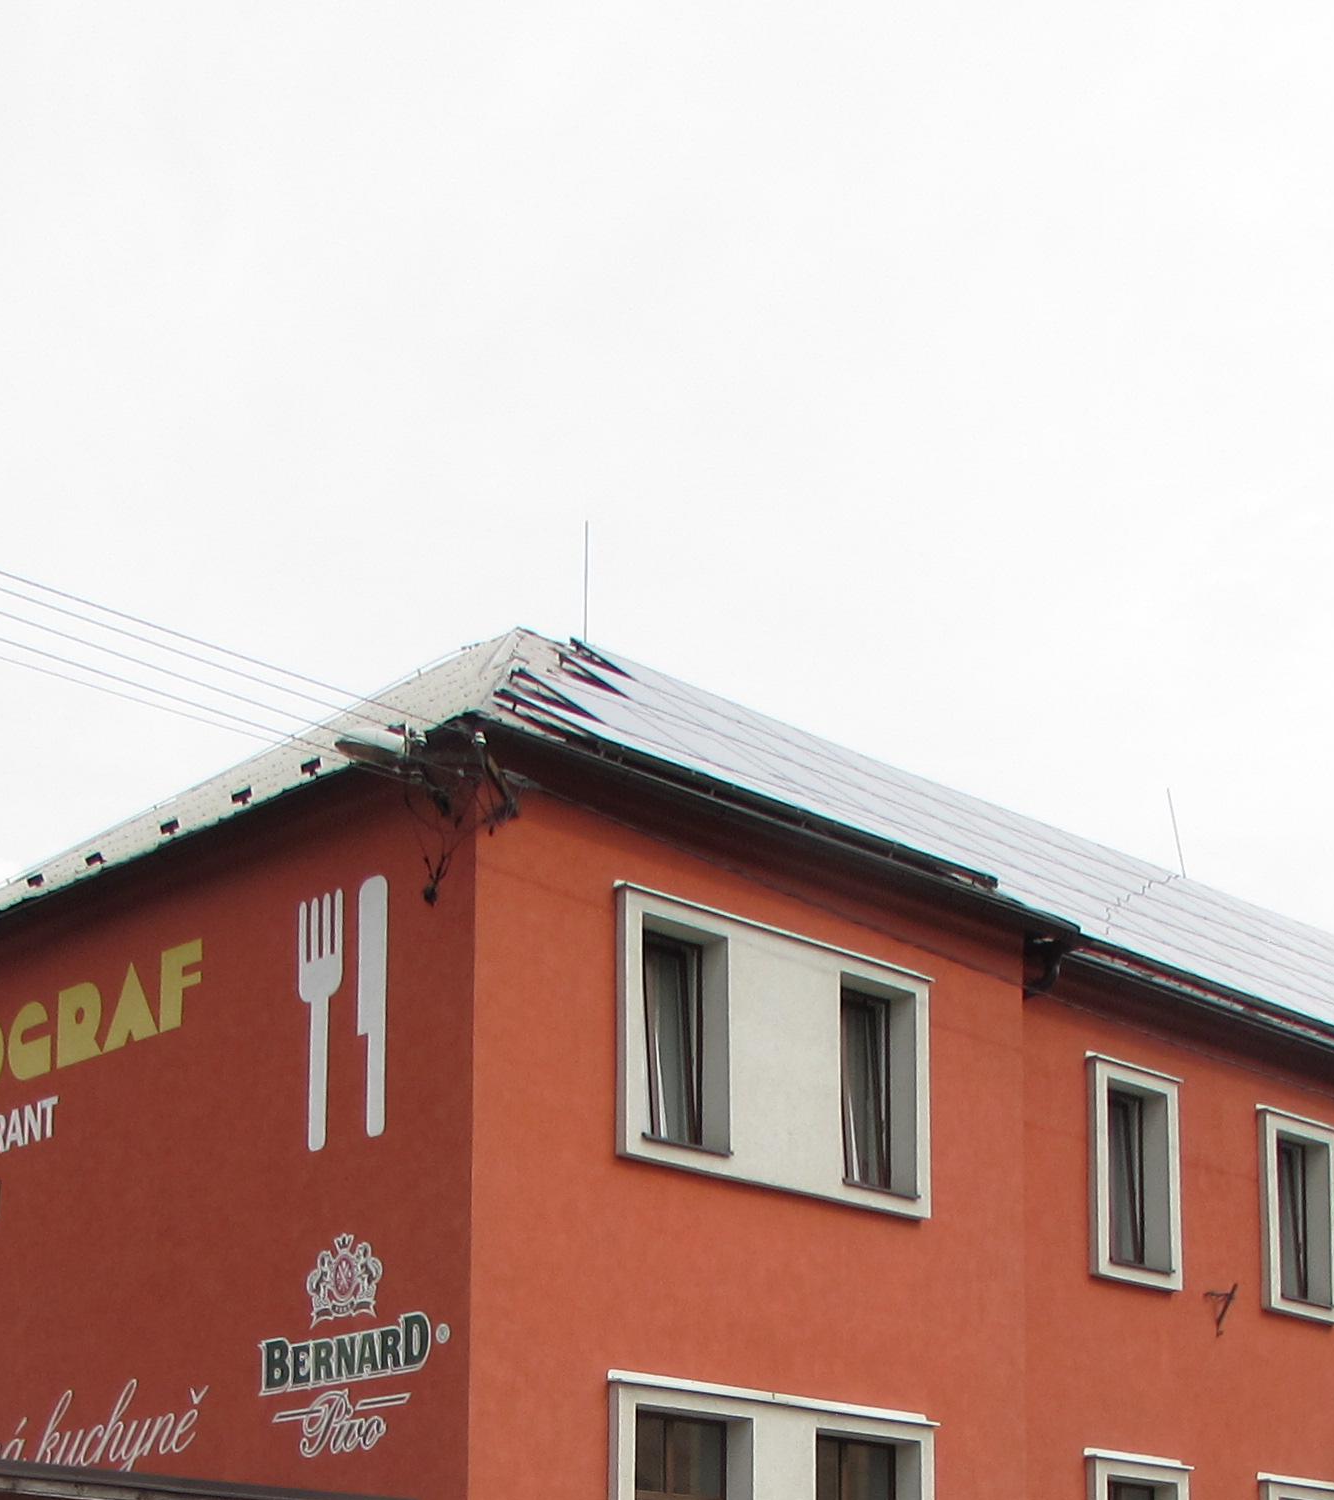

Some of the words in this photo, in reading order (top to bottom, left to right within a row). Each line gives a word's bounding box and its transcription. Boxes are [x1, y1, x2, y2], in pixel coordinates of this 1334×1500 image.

[259, 1310, 432, 1397] BERNARD
[34, 1378, 210, 1473] kuchyně
[299, 1388, 388, 1459] Pivo
